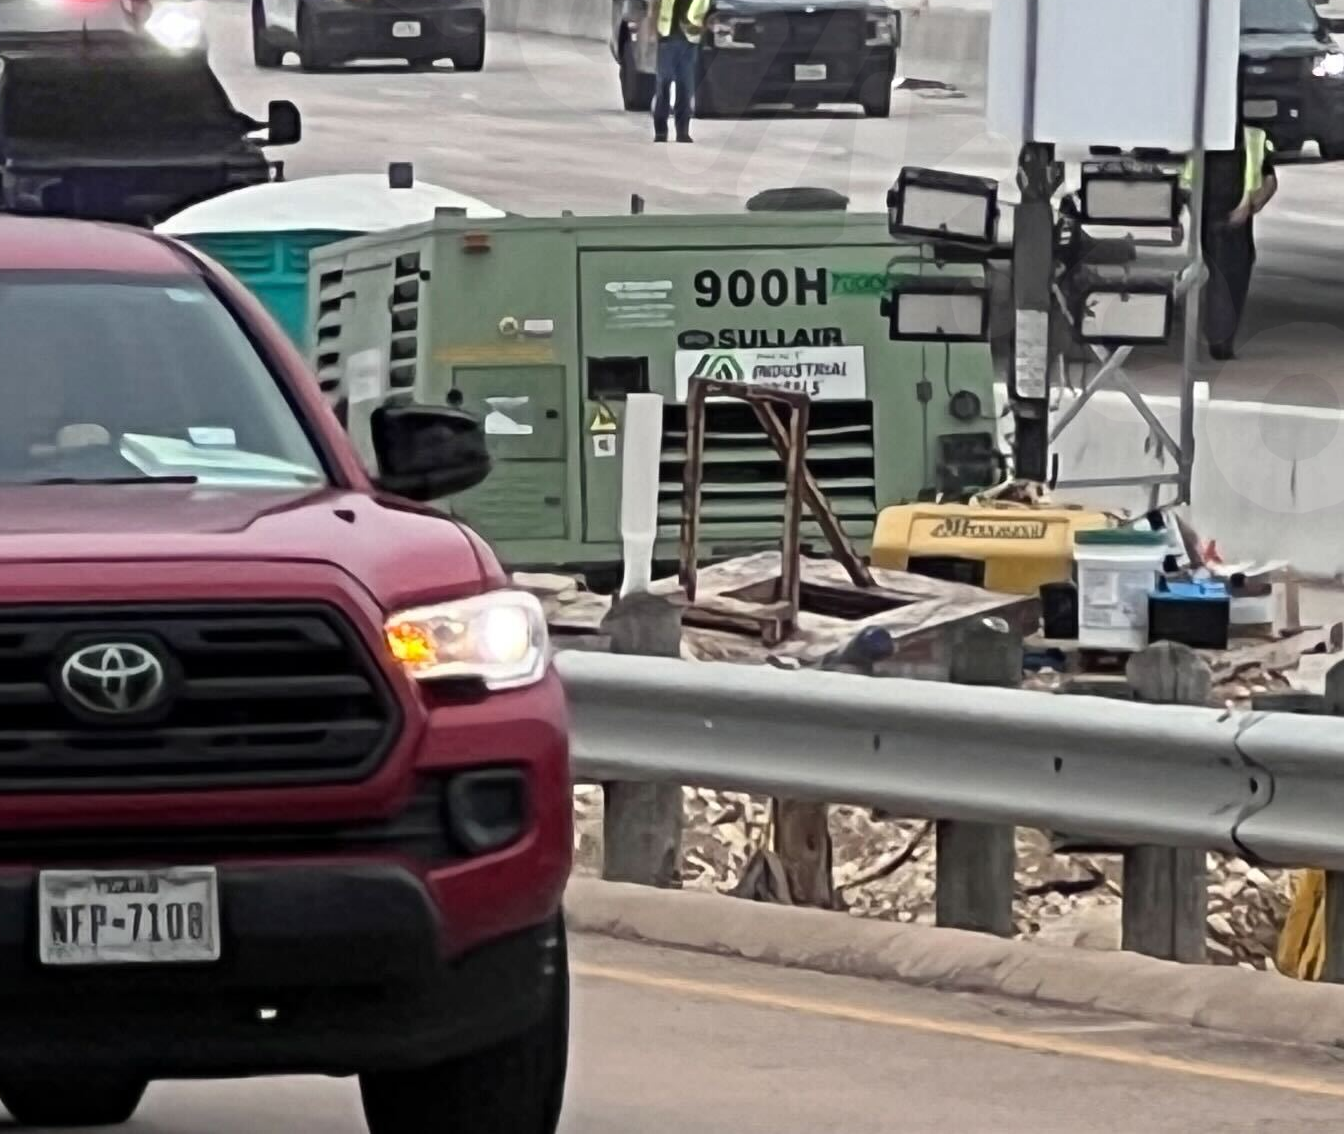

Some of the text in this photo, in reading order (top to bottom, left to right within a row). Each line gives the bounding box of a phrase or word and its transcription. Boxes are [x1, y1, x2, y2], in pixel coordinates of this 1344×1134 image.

[693, 267, 827, 307] 900H
[718, 327, 844, 349] SULLAIR
[50, 901, 204, 945] NFP-7108
